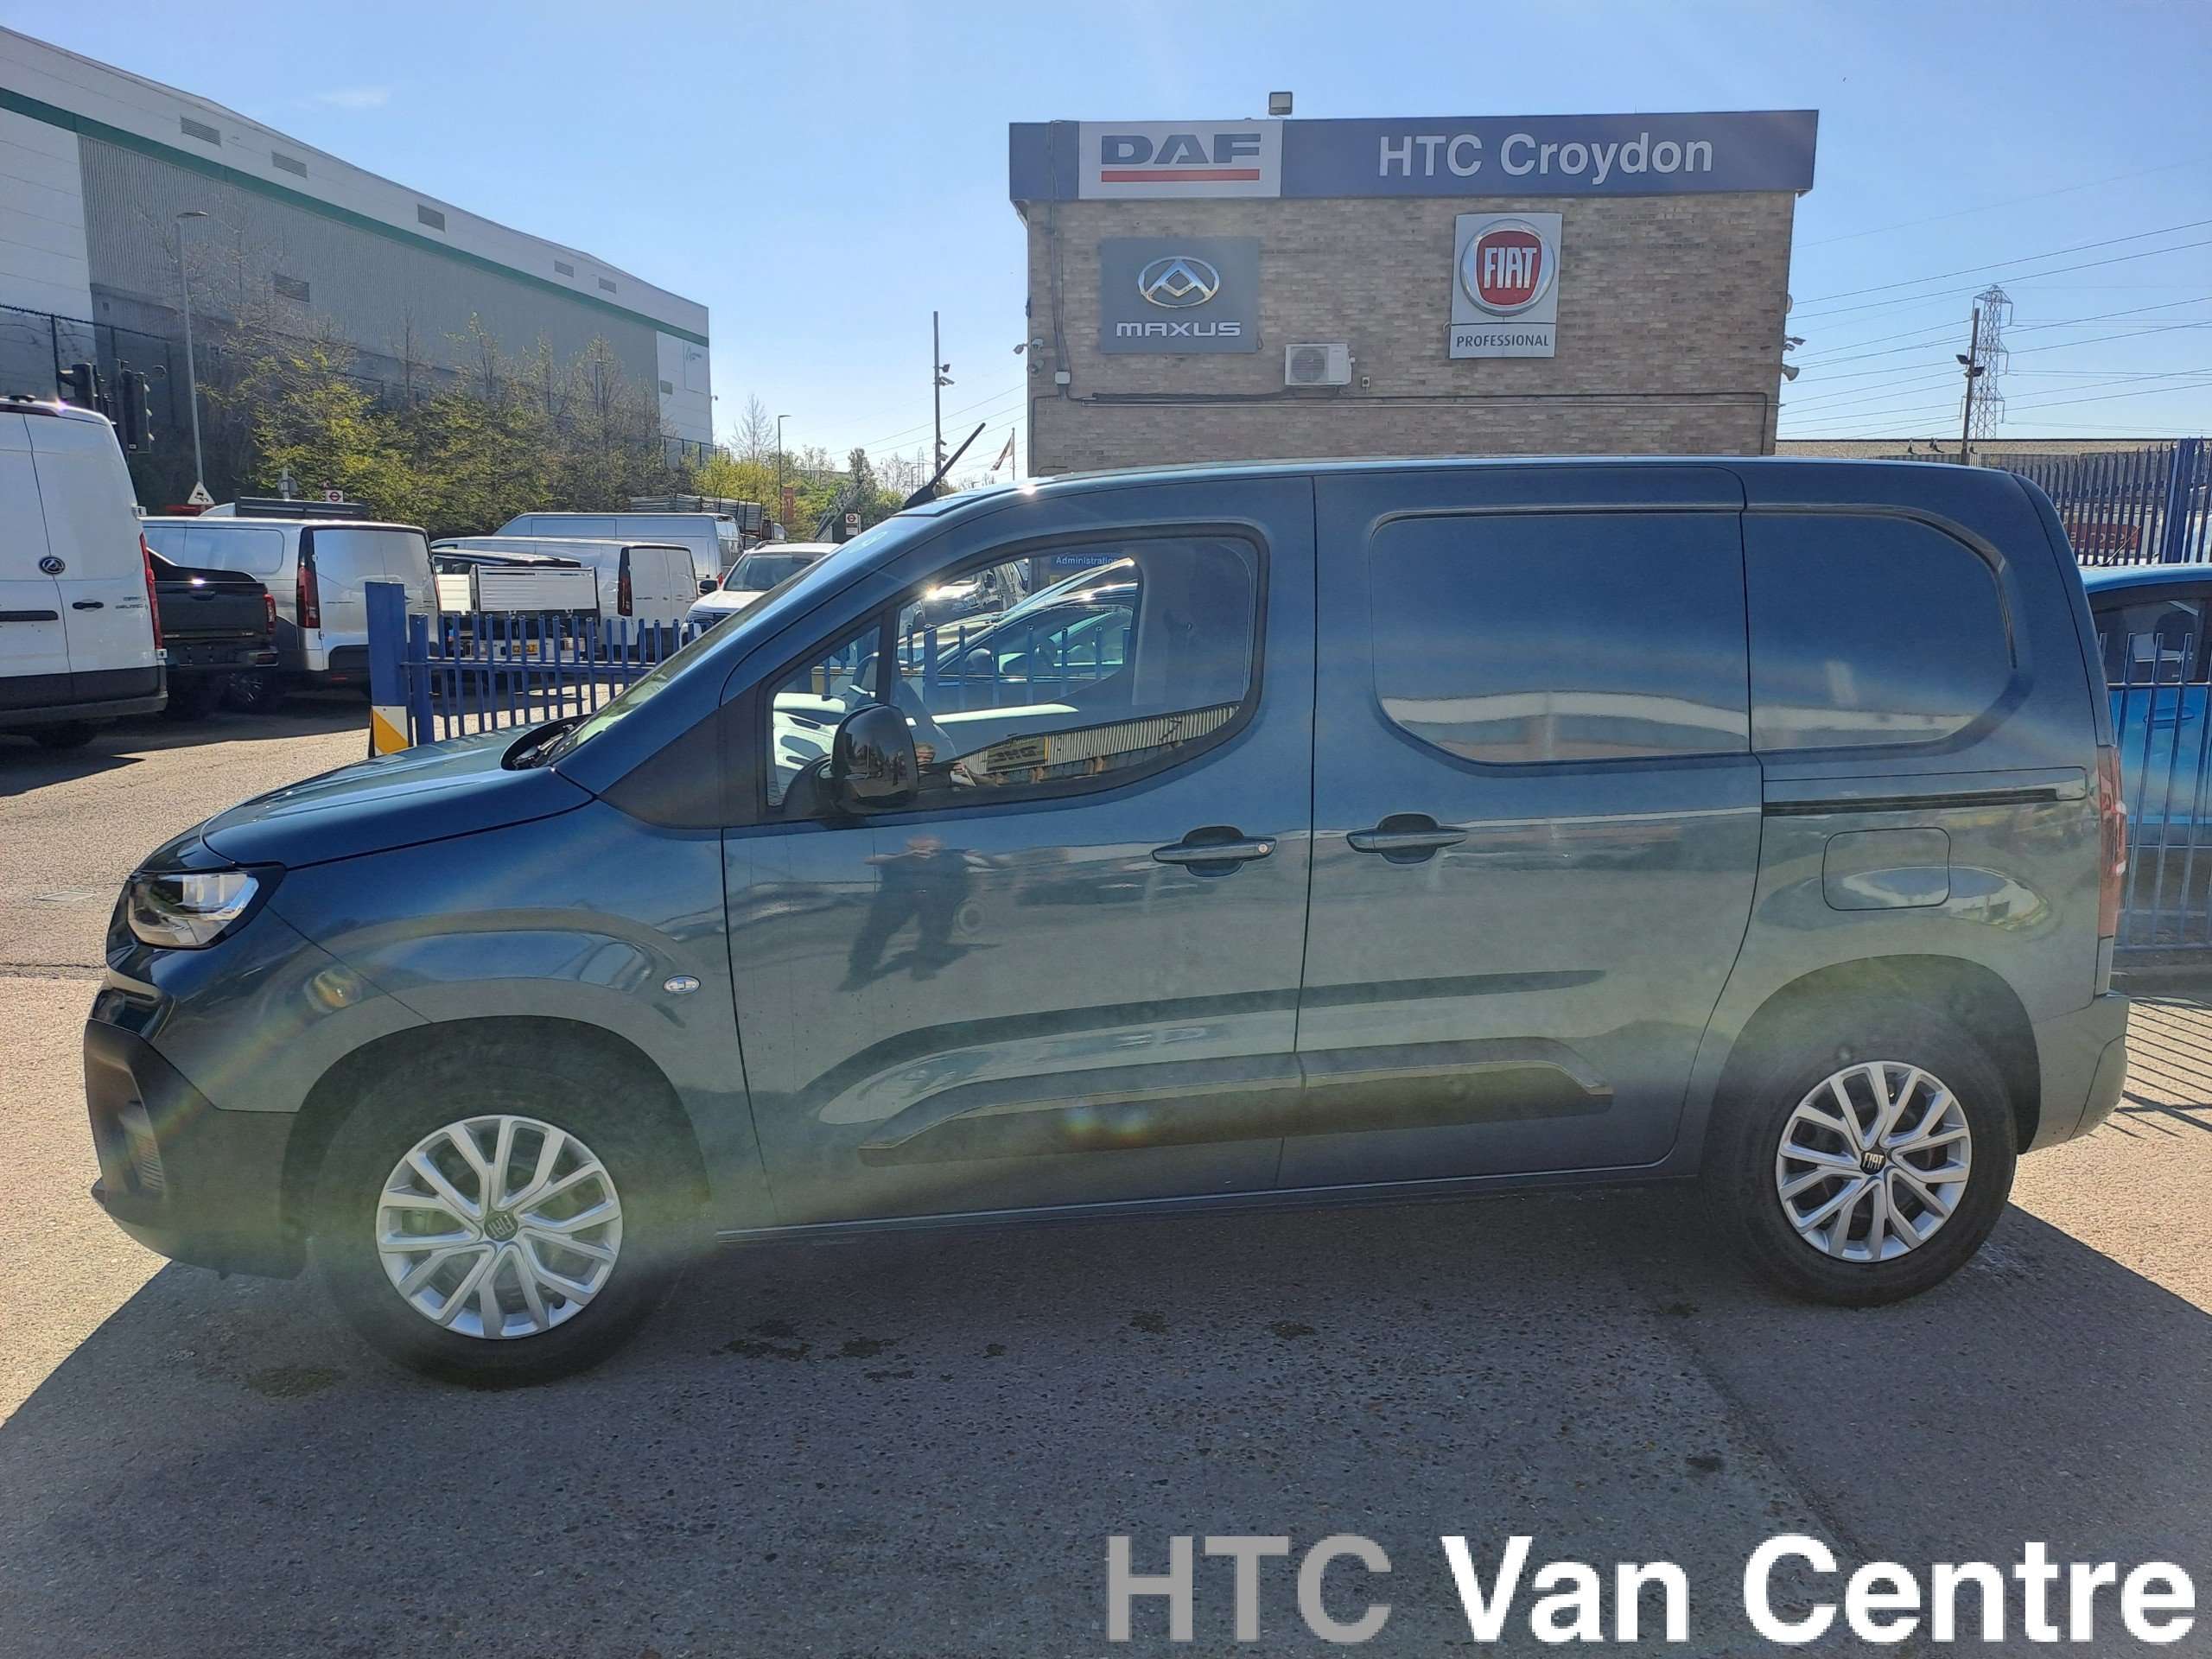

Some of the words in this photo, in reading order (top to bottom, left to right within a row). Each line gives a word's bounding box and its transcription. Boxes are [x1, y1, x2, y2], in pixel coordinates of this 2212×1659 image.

[1101, 133, 1262, 164] DAF
[1379, 134, 1483, 177] HTC
[1500, 132, 1713, 185] Croydon
[1483, 247, 1538, 289] FIAT
[1116, 321, 1242, 337] MAXUS
[1456, 334, 1549, 347] PROFESSIONAL
[1862, 1152, 1885, 1170] FIAT
